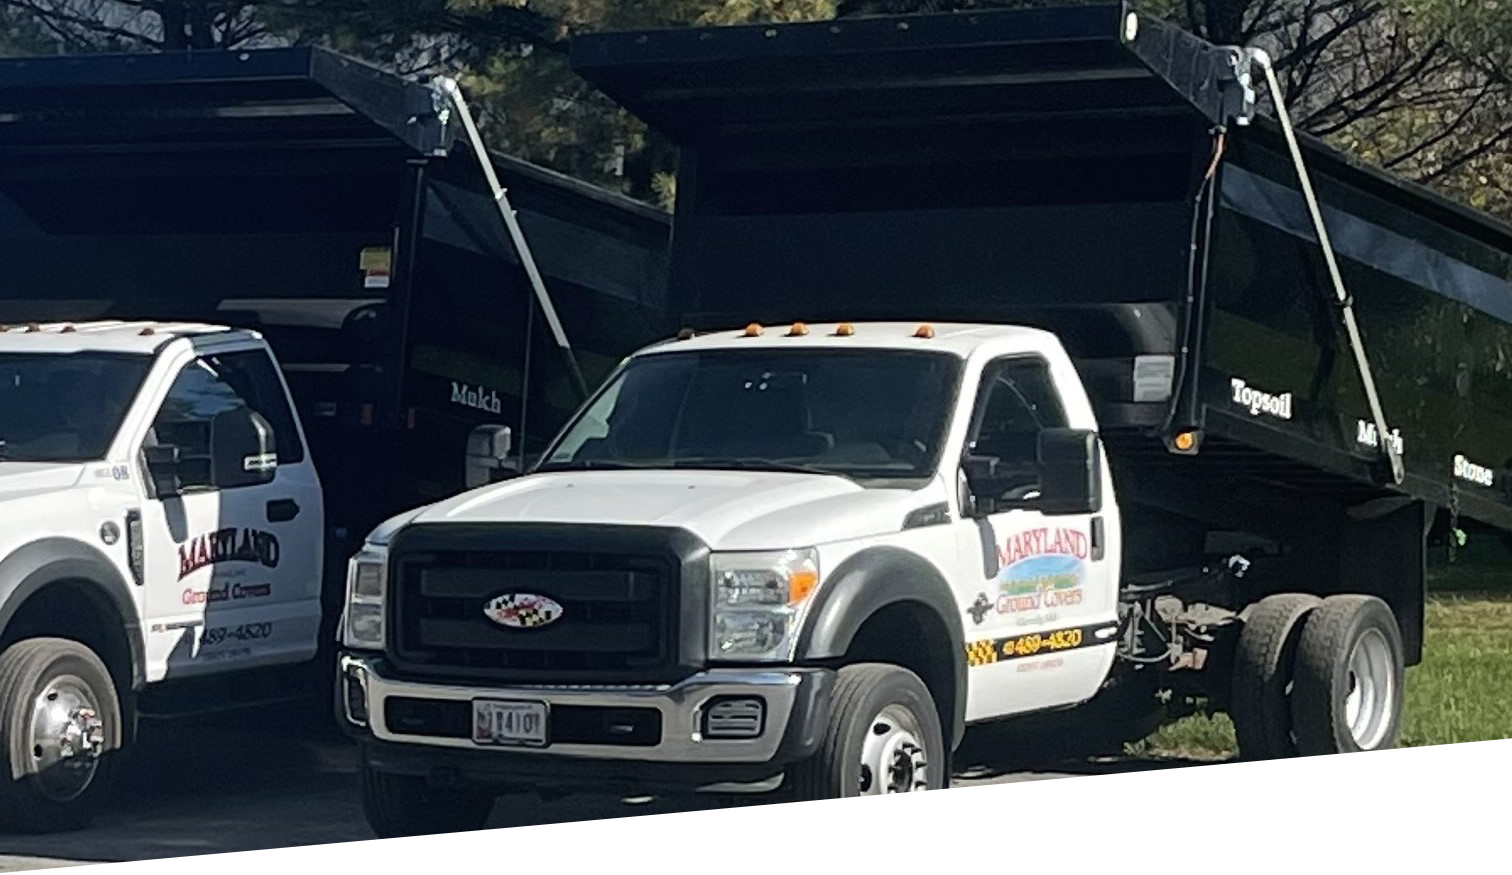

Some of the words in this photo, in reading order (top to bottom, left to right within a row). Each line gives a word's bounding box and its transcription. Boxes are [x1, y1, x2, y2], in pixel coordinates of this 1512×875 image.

[451, 381, 502, 414] Mulch
[1231, 377, 1291, 419] Topsoil
[1454, 454, 1493, 486] Stone
[177, 527, 280, 582] MARYLAND
[998, 527, 1088, 569] MARYLAND
[182, 582, 230, 605] Ground
[996, 585, 1041, 615] Ground
[1044, 585, 1083, 608] Covers
